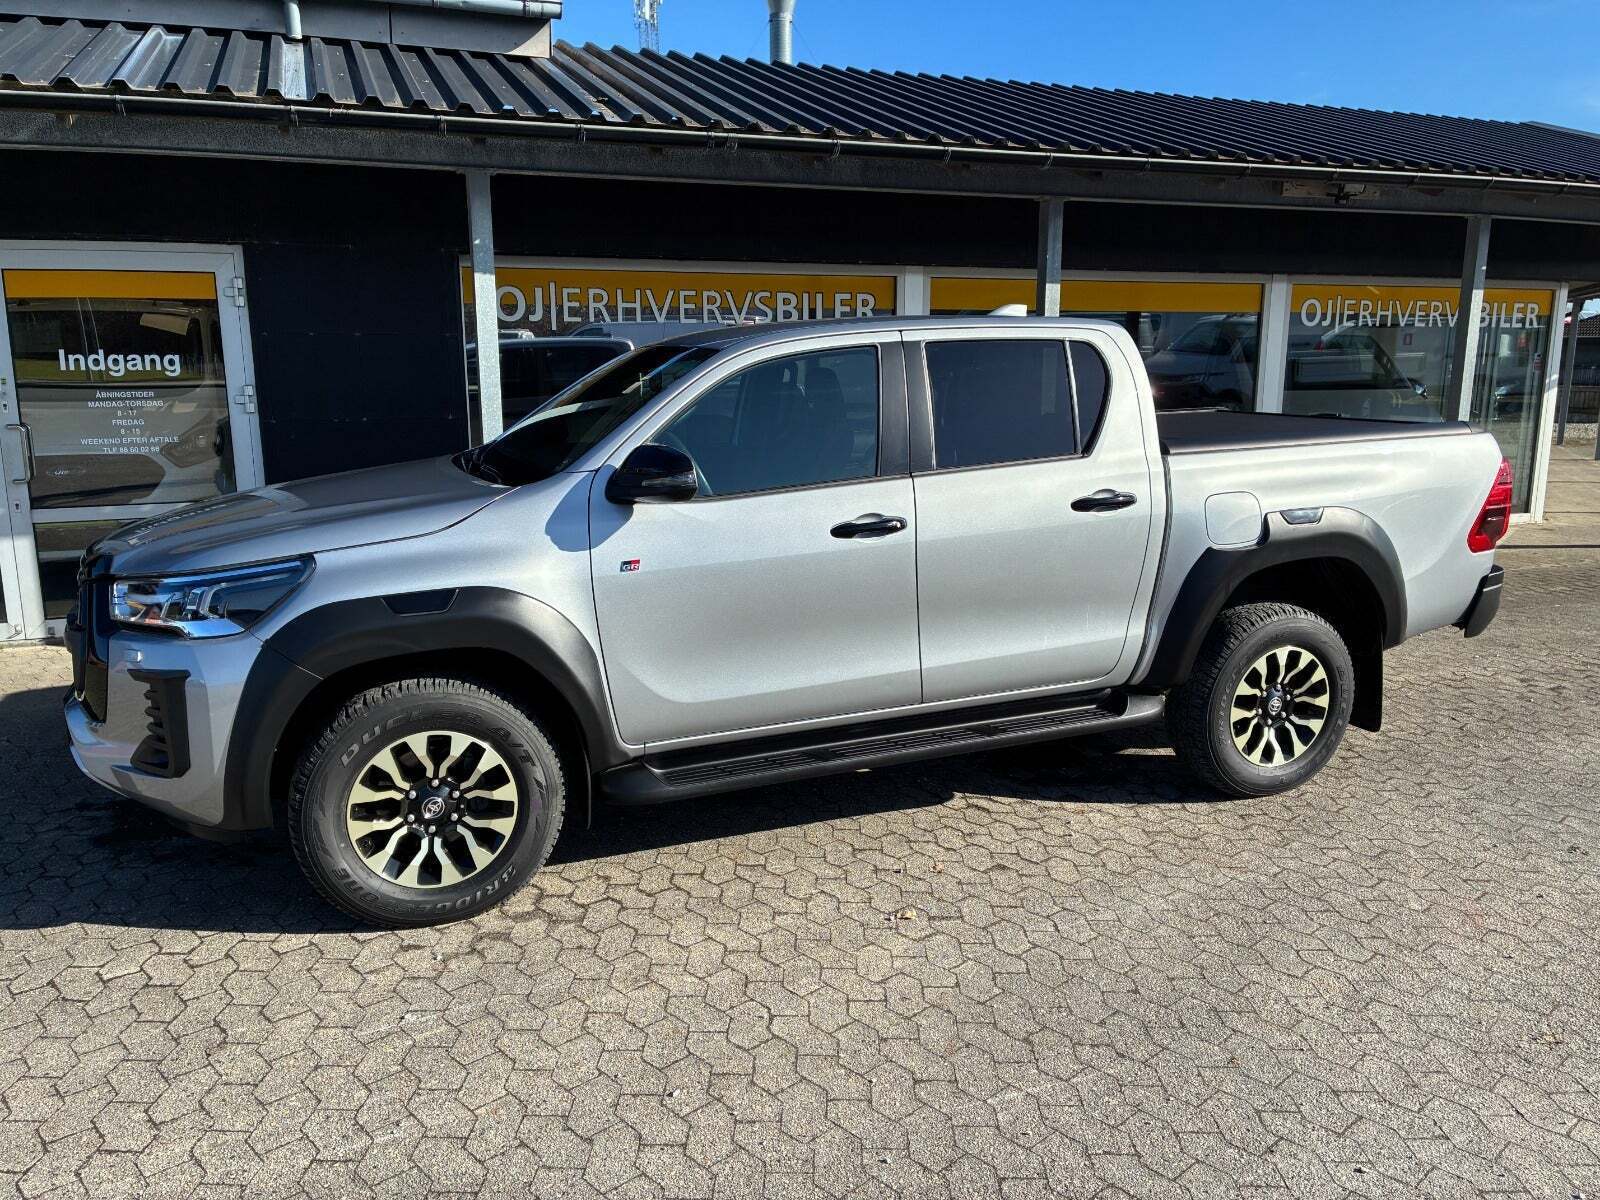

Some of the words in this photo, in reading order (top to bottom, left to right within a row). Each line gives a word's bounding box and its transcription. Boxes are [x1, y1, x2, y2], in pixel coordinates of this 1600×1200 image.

[58, 349, 181, 377] Indgang
[95, 390, 155, 398] ÅBNINGSTIDER
[87, 400, 164, 408] MANDAG-TORSDAG
